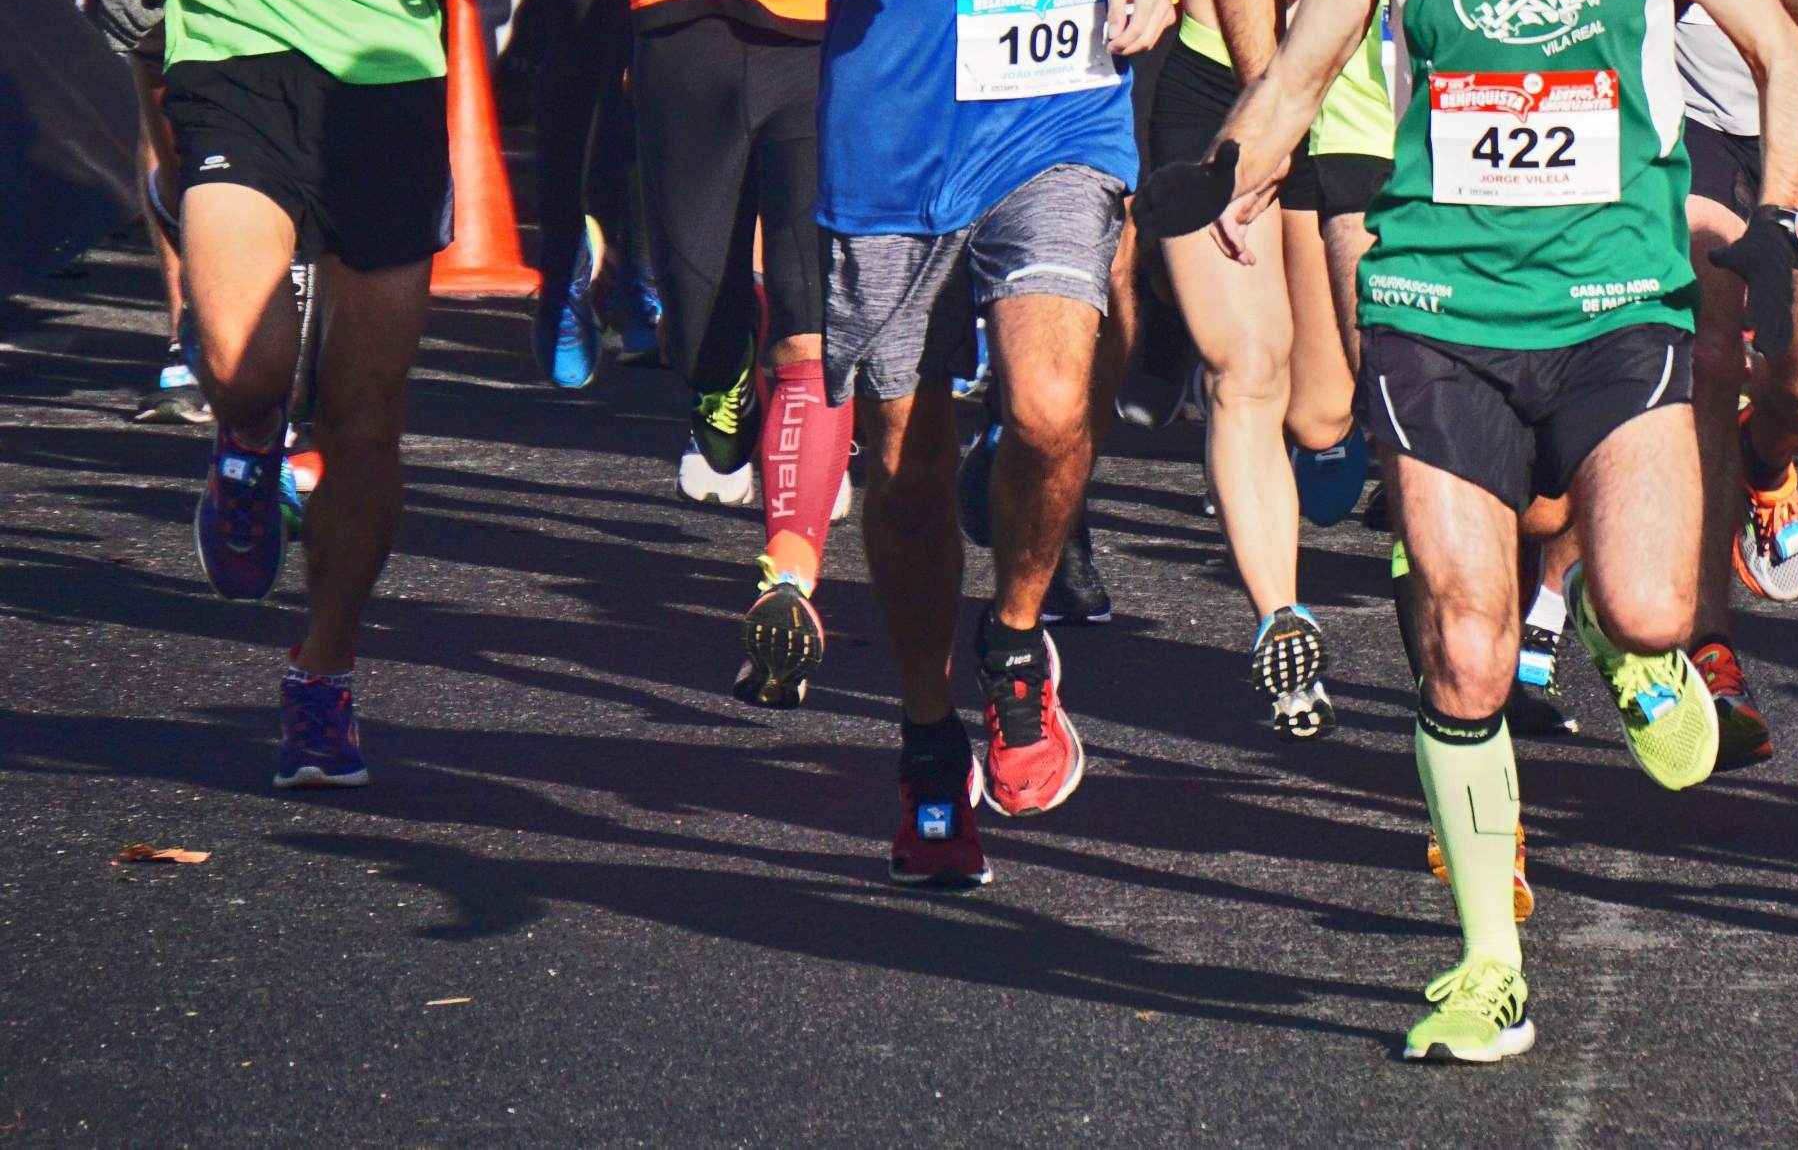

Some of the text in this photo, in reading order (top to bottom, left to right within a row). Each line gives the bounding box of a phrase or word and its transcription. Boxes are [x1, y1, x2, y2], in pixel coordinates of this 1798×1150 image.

[999, 19, 1079, 65] 109
[1541, 19, 1606, 57] VILA REAL
[1002, 67, 1031, 80] JOÃO
[1439, 89, 1526, 112] BENFIQUISTA
[1472, 126, 1576, 169] 422
[1479, 173, 1570, 184] JORGE VILELA
[1368, 274, 1453, 299] CHURRASCARIA
[1605, 282, 1626, 296] DO
[1371, 288, 1445, 314] ROYAL
[1582, 297, 1601, 313] DE
